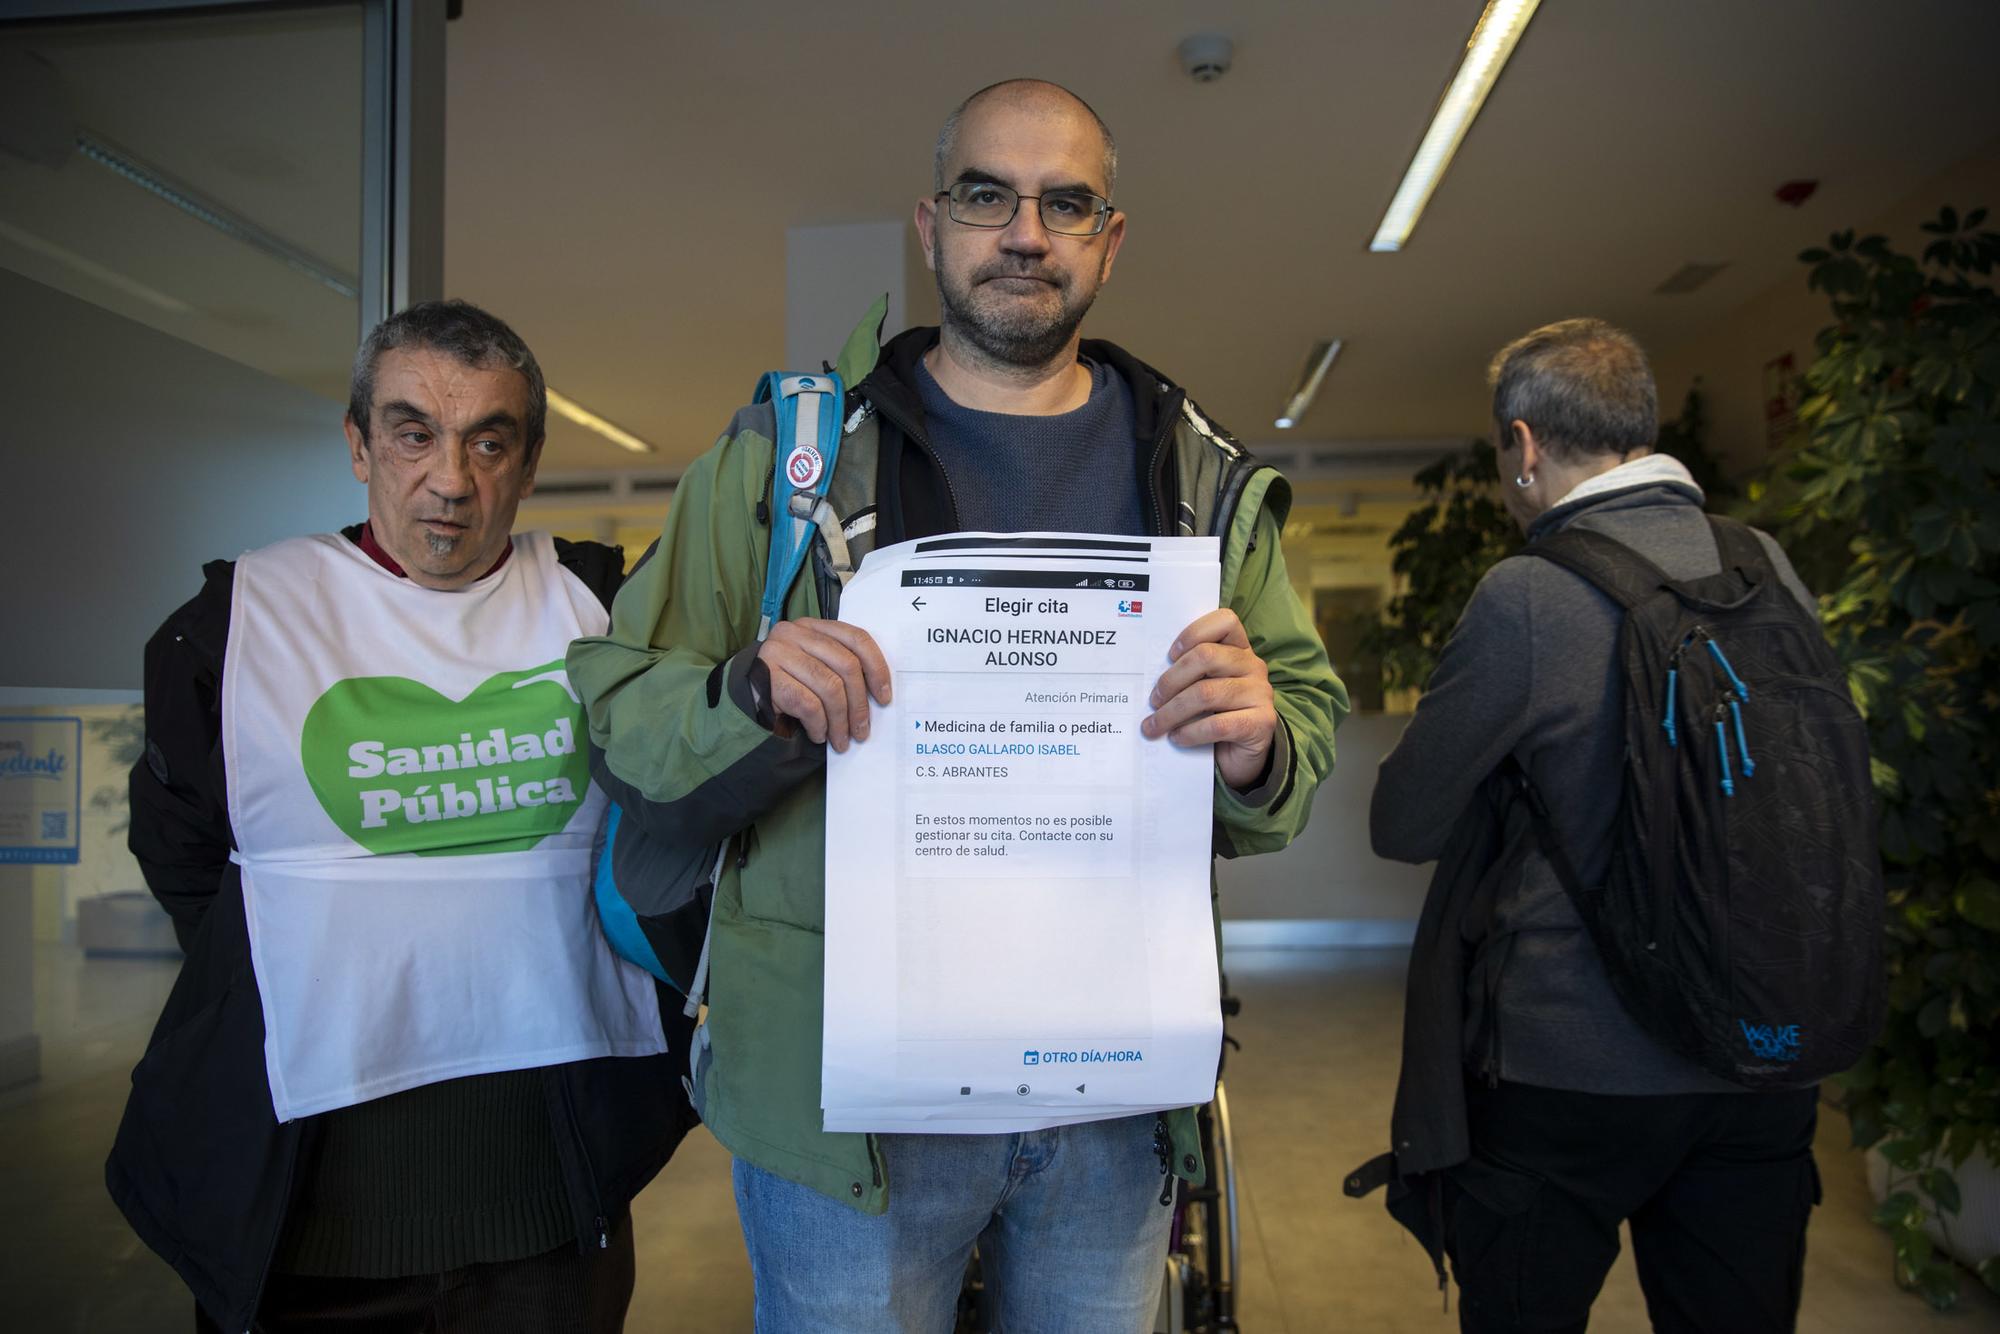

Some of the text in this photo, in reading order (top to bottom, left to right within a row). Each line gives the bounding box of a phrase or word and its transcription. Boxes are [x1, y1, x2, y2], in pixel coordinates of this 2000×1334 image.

[912, 576, 934, 585] 11:45
[986, 597, 1068, 616] Elegir cita
[928, 628, 1116, 645] IGNACIO HERNANDEZ
[985, 652, 1057, 666] ALONSO
[1025, 692, 1128, 703] Atención Primaria
[925, 720, 985, 732] Medicina
[990, 721, 1005, 732] de
[1010, 721, 1054, 733] familia
[1059, 724, 1067, 733] o
[348, 717, 576, 778] Sanidad
[916, 744, 1080, 755] BLASCO GALLARDO ISABEL
[916, 766, 1008, 777] C.S. ABRANTES
[360, 776, 577, 829] Pública
[916, 814, 930, 824] En
[934, 816, 965, 825] estos
[969, 816, 1032, 825] momentos
[1036, 817, 1050, 825] no
[1071, 815, 1112, 828] posible
[915, 830, 970, 843] gestionar
[974, 832, 987, 840] su
[991, 830, 1015, 840] cita.
[1020, 830, 1071, 840] Contacte
[915, 845, 1008, 856] centro de salud.
[1043, 1049, 1142, 1063] OTRO DÍA/HORA
